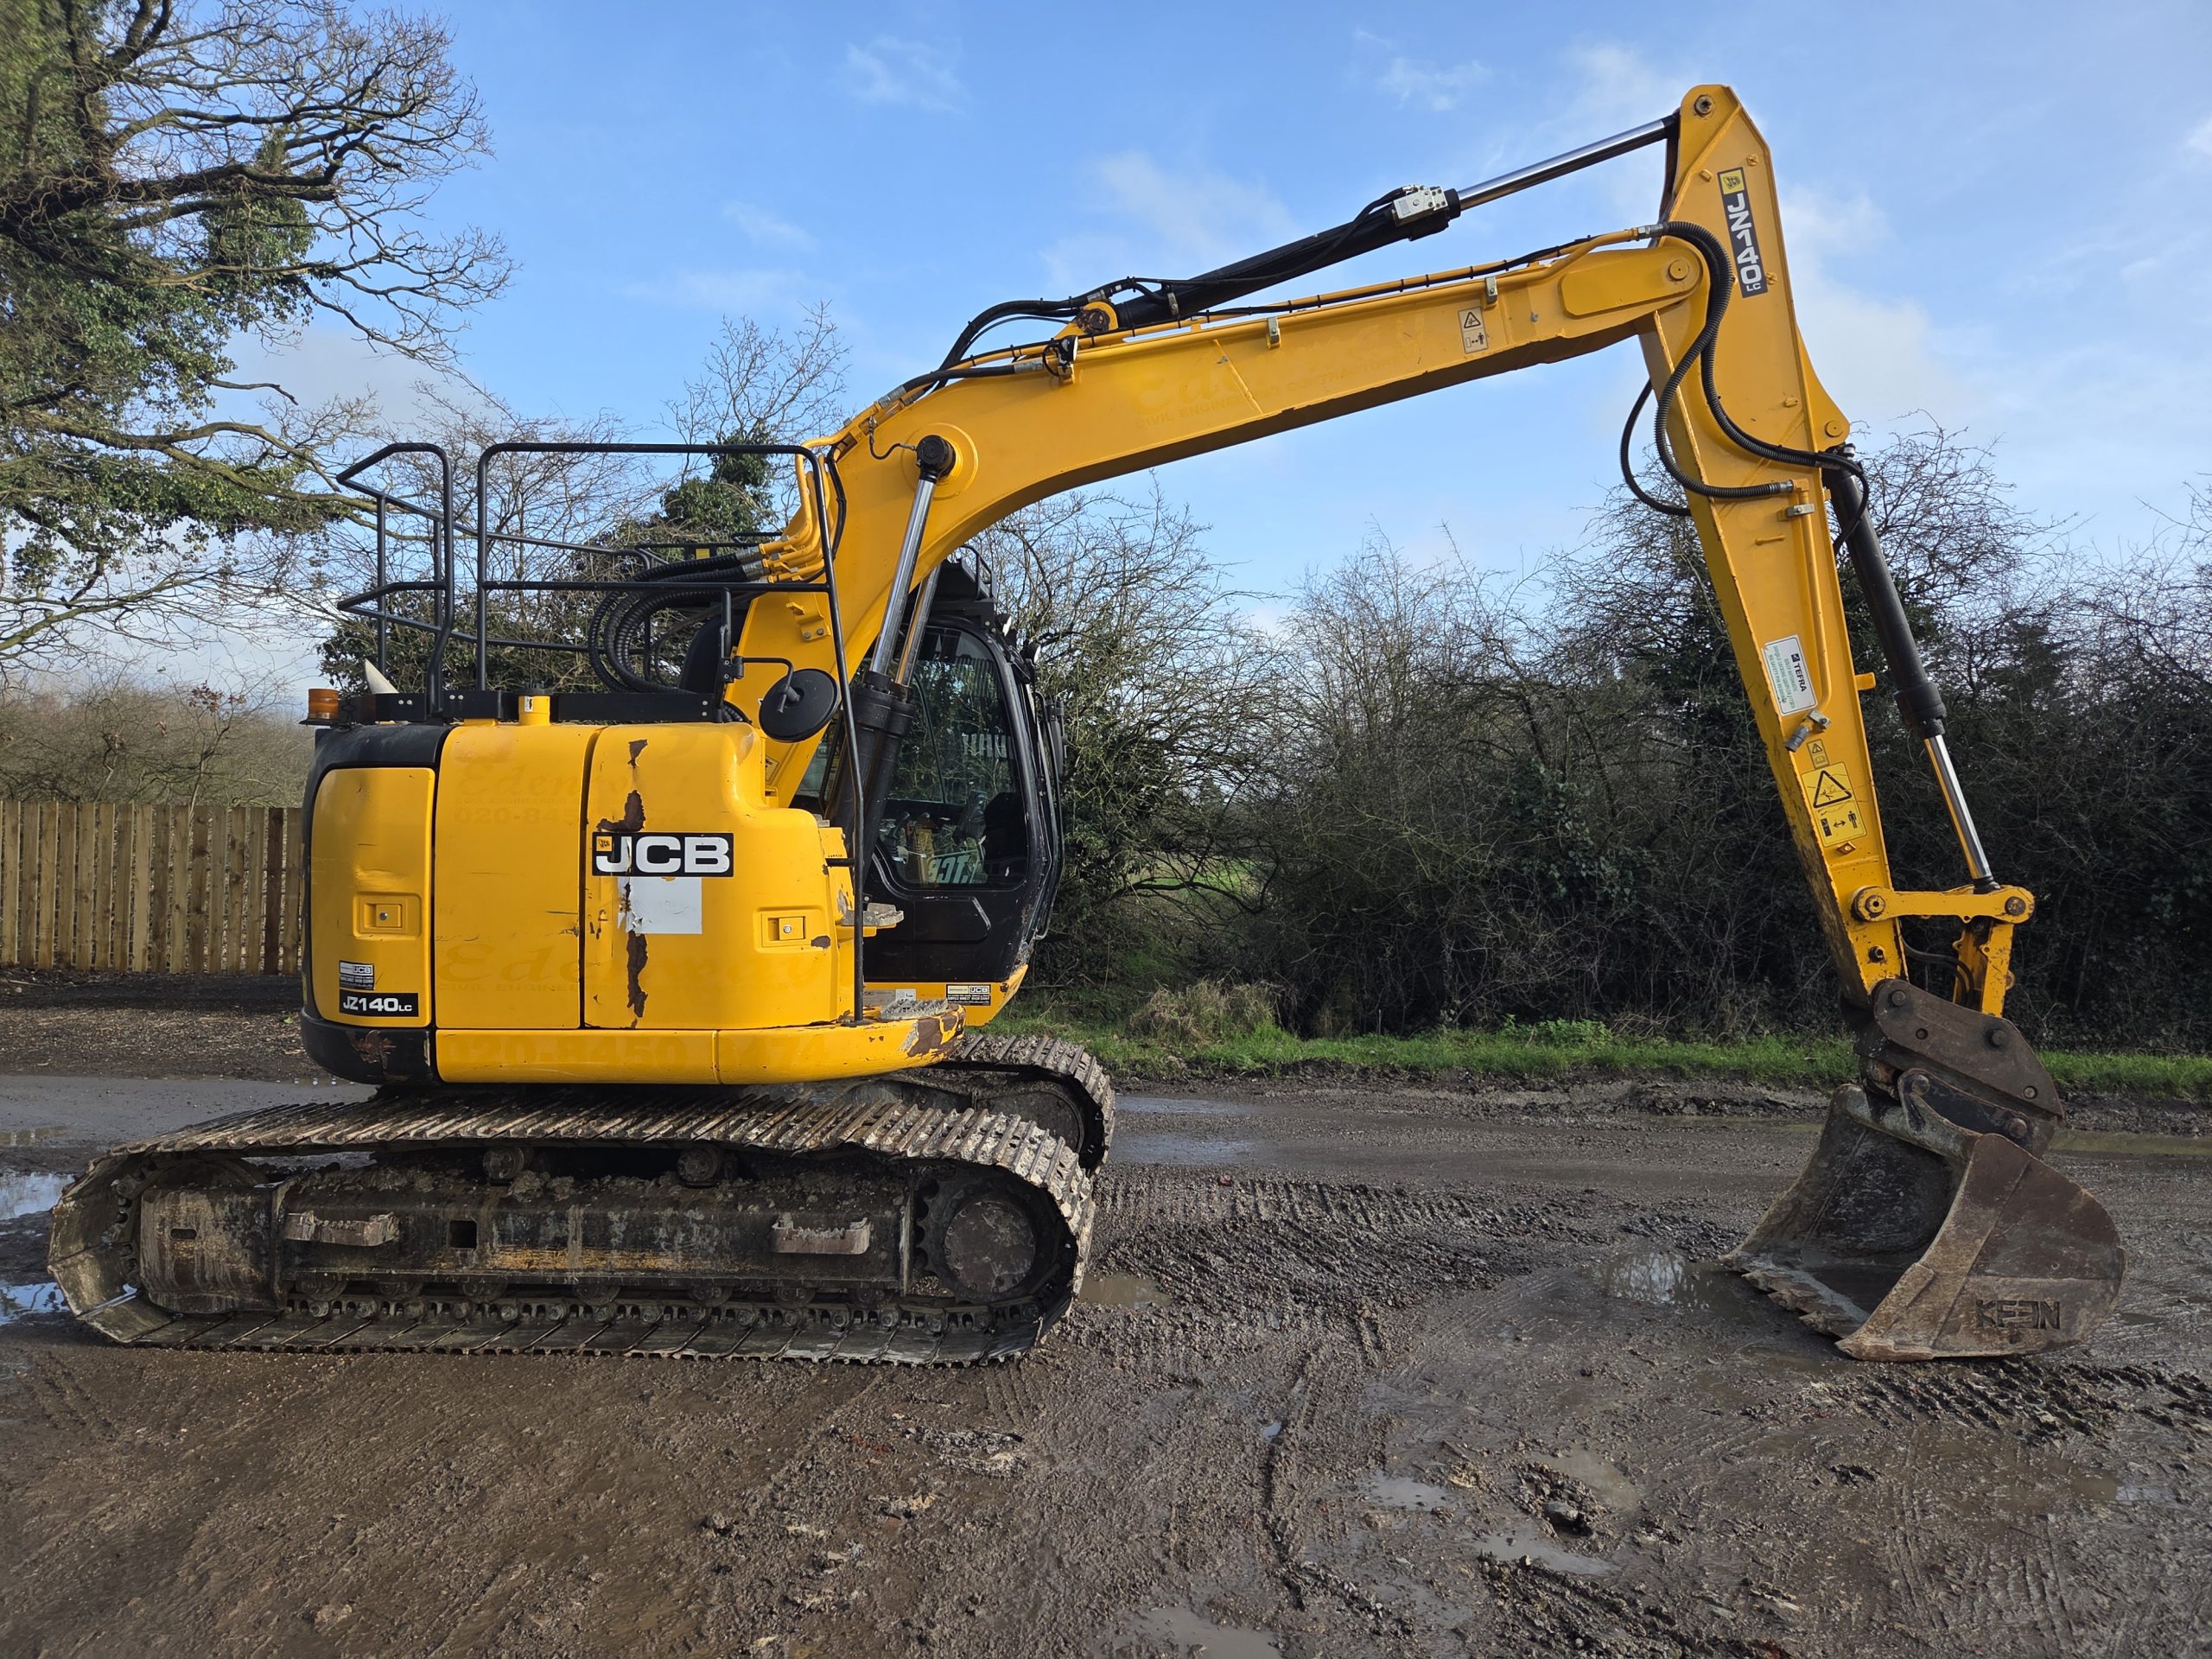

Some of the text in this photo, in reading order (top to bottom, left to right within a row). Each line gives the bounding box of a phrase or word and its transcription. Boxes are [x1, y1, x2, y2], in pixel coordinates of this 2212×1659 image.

[1794, 663, 1808, 692] TEFRA
[596, 836, 730, 873] JCB
[353, 965, 372, 974] JCB
